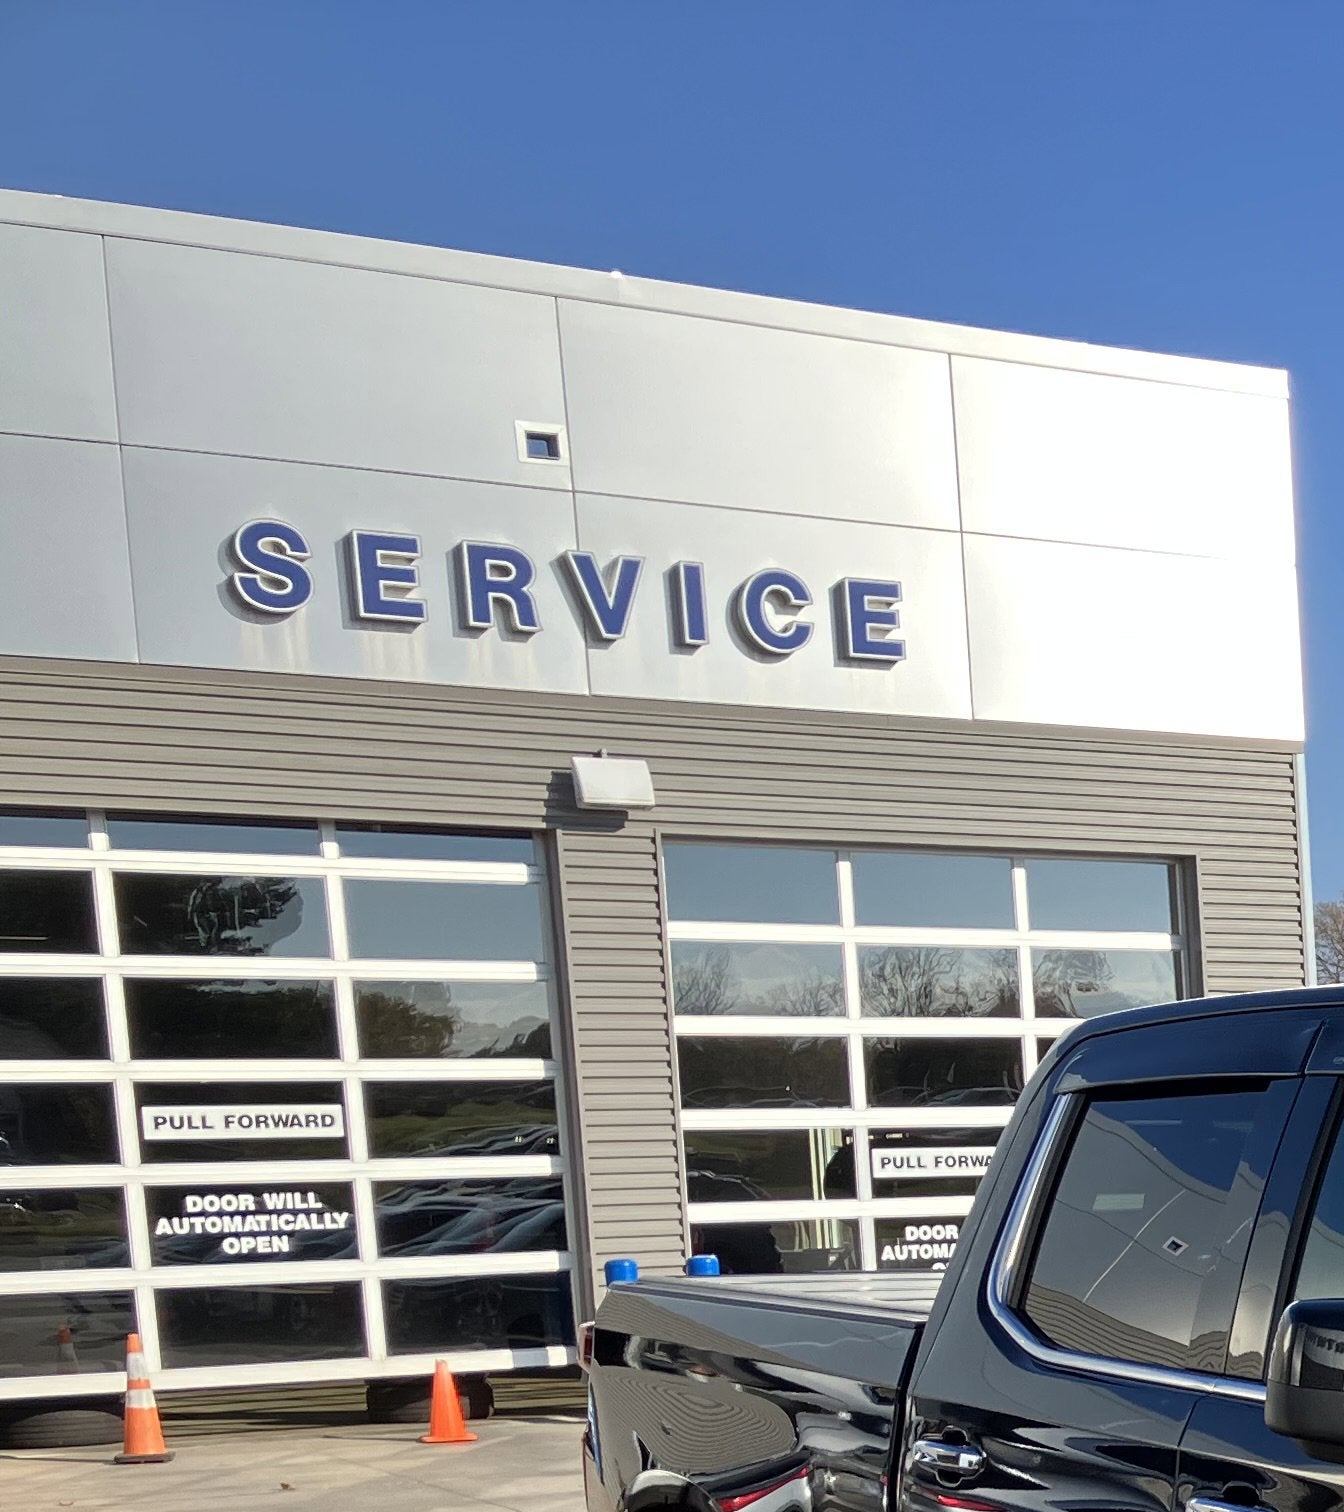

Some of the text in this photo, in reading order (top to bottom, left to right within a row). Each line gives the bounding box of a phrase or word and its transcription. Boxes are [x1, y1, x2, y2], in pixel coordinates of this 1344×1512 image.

[230, 517, 907, 664] SERVICE
[153, 1113, 336, 1130] PULL FORWARD
[880, 1156, 927, 1169] PULL
[185, 1191, 323, 1213] DOOR WILL
[155, 1211, 350, 1236] AUTOMATICALLY
[904, 1224, 959, 1242] DOOR
[222, 1235, 290, 1255] OPEN
